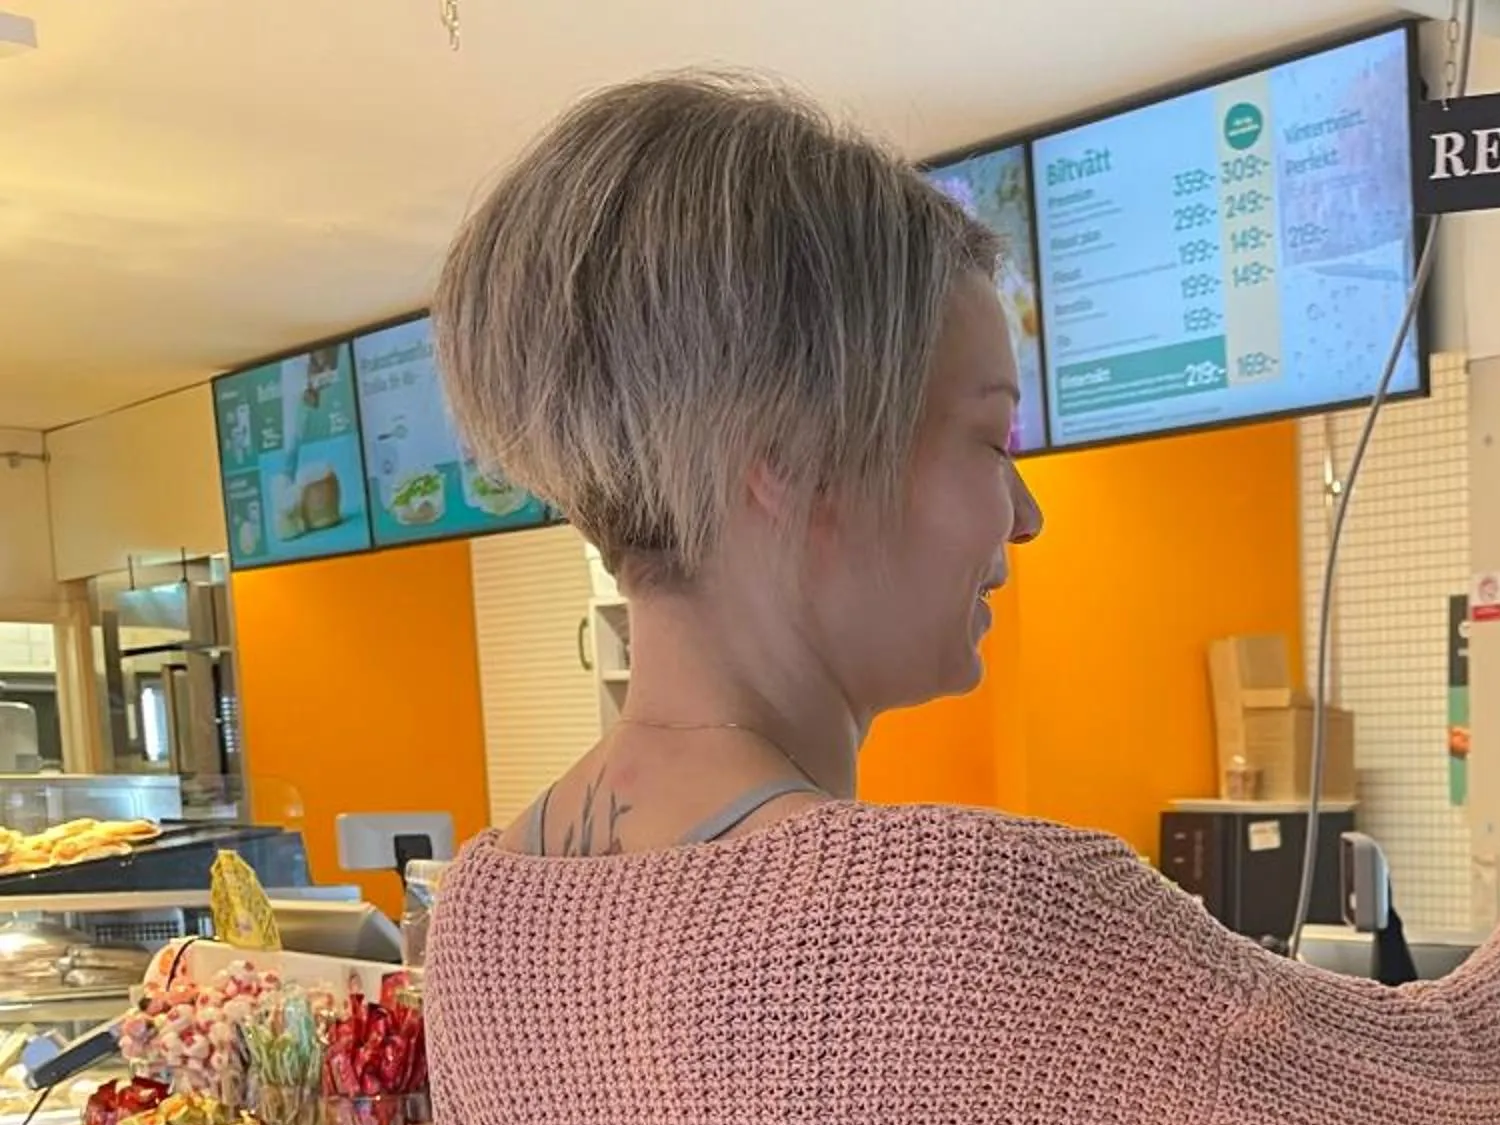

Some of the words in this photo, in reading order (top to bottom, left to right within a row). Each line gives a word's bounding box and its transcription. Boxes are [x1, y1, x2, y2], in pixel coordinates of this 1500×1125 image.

[1221, 154, 1270, 184] 309:-
[1225, 190, 1272, 219] 249:-
[1230, 227, 1273, 253] 149:-
[1232, 261, 1275, 287] 149:-
